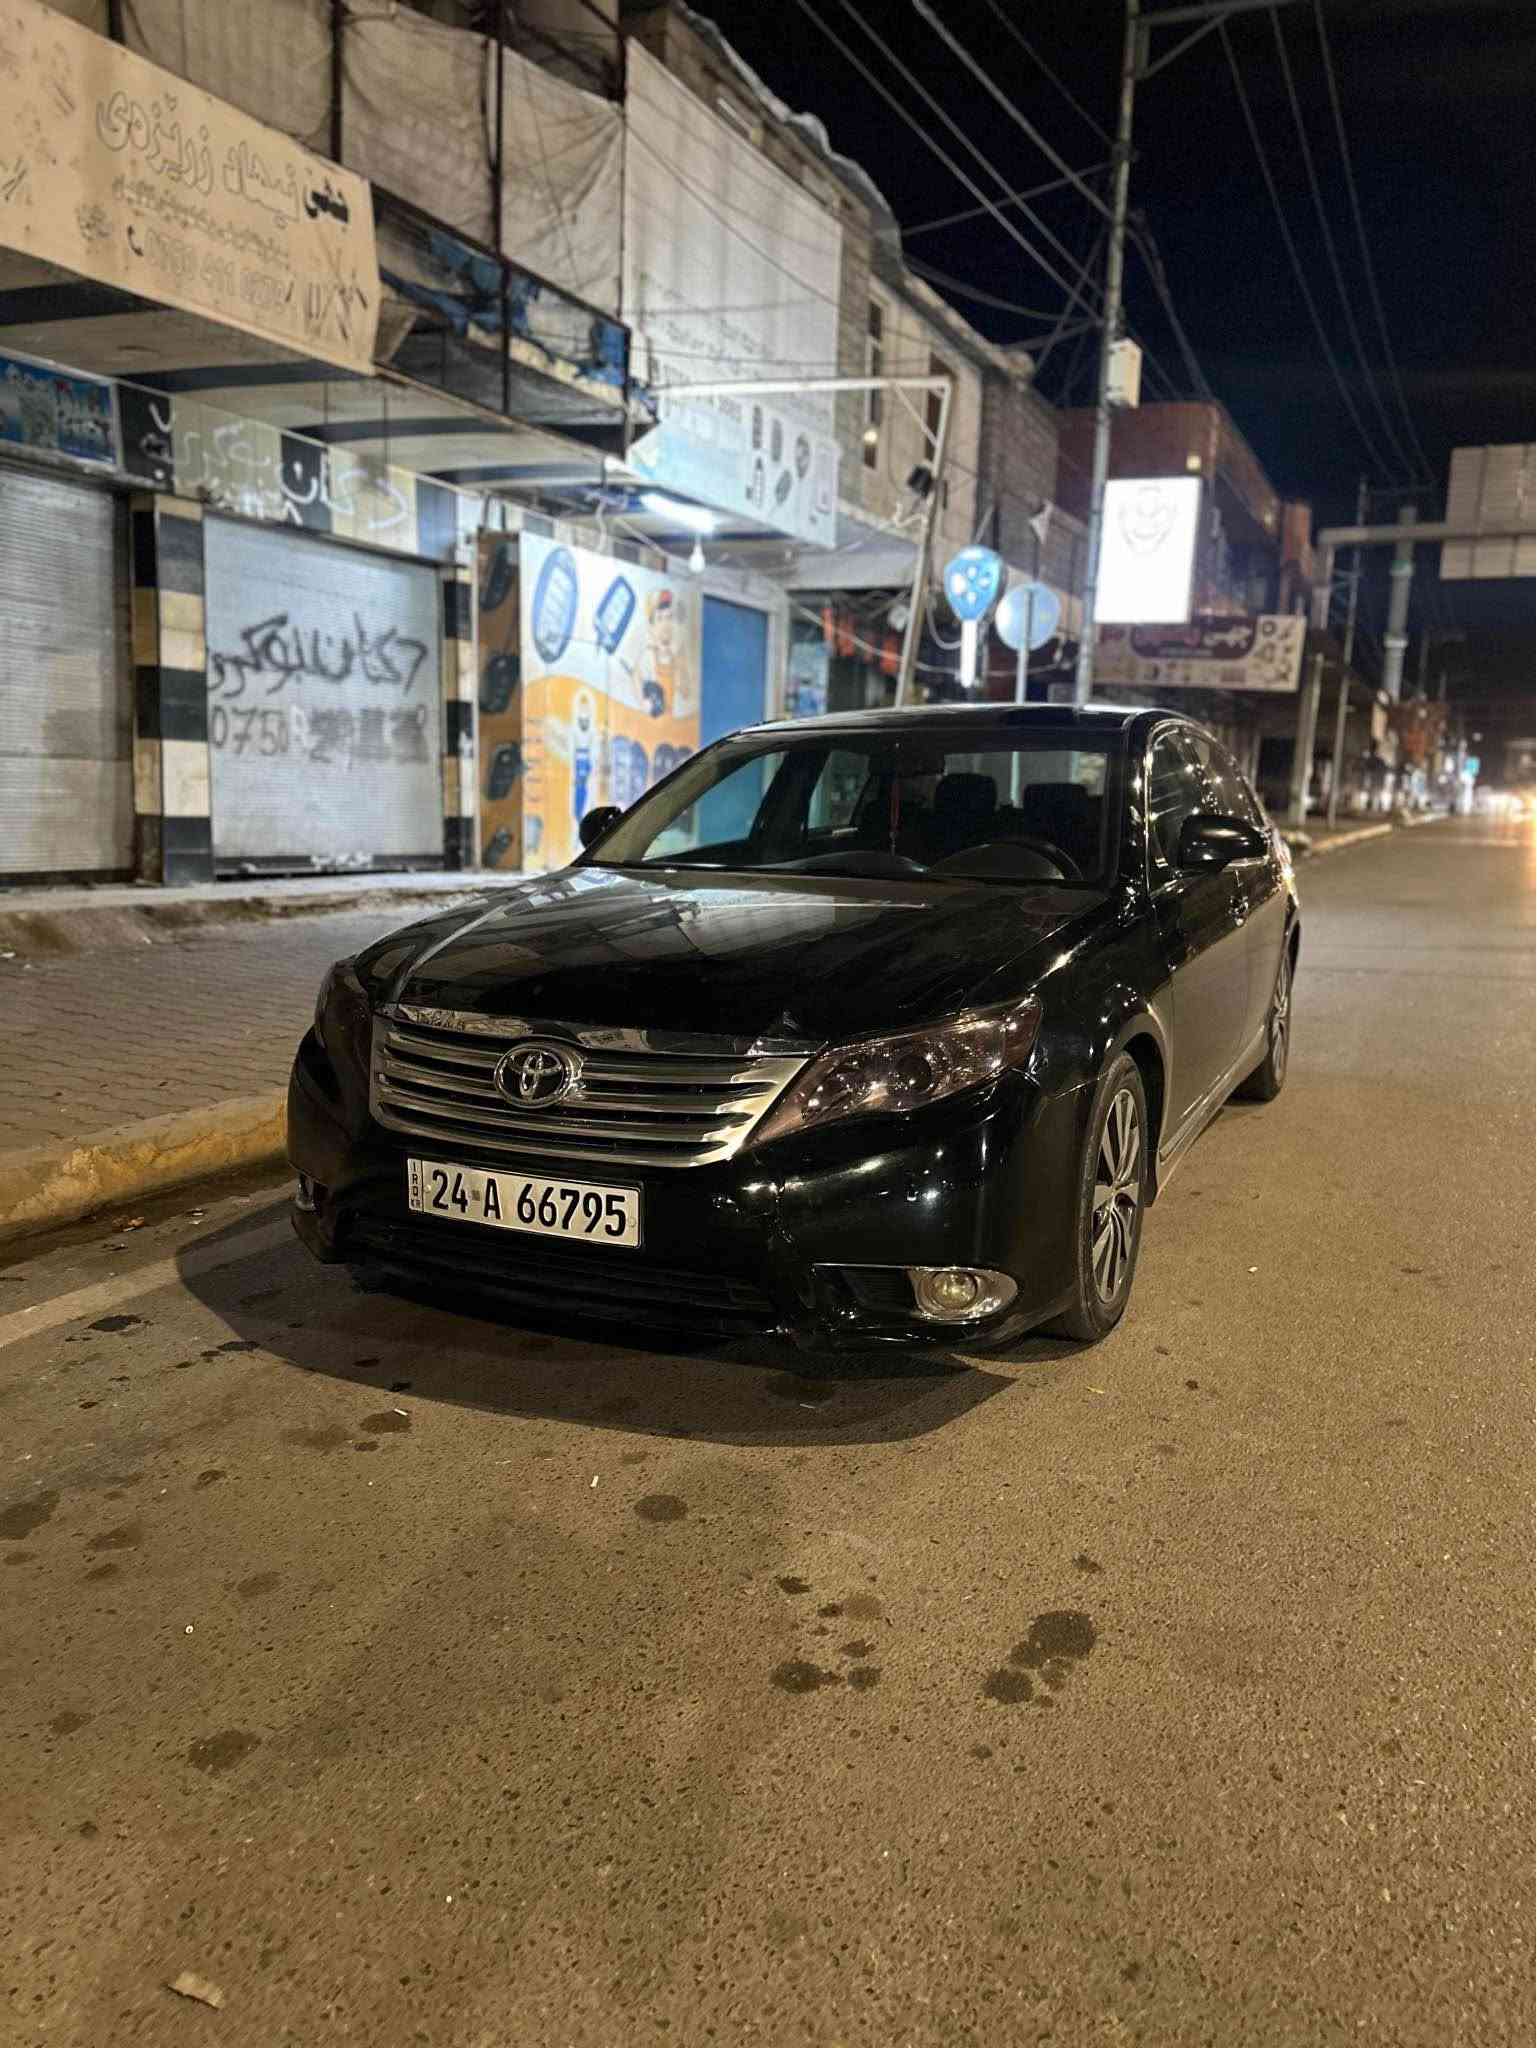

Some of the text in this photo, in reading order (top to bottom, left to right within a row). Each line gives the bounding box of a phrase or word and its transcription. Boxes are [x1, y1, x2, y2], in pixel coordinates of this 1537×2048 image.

[432, 1168, 626, 1237] 24 A 66795
